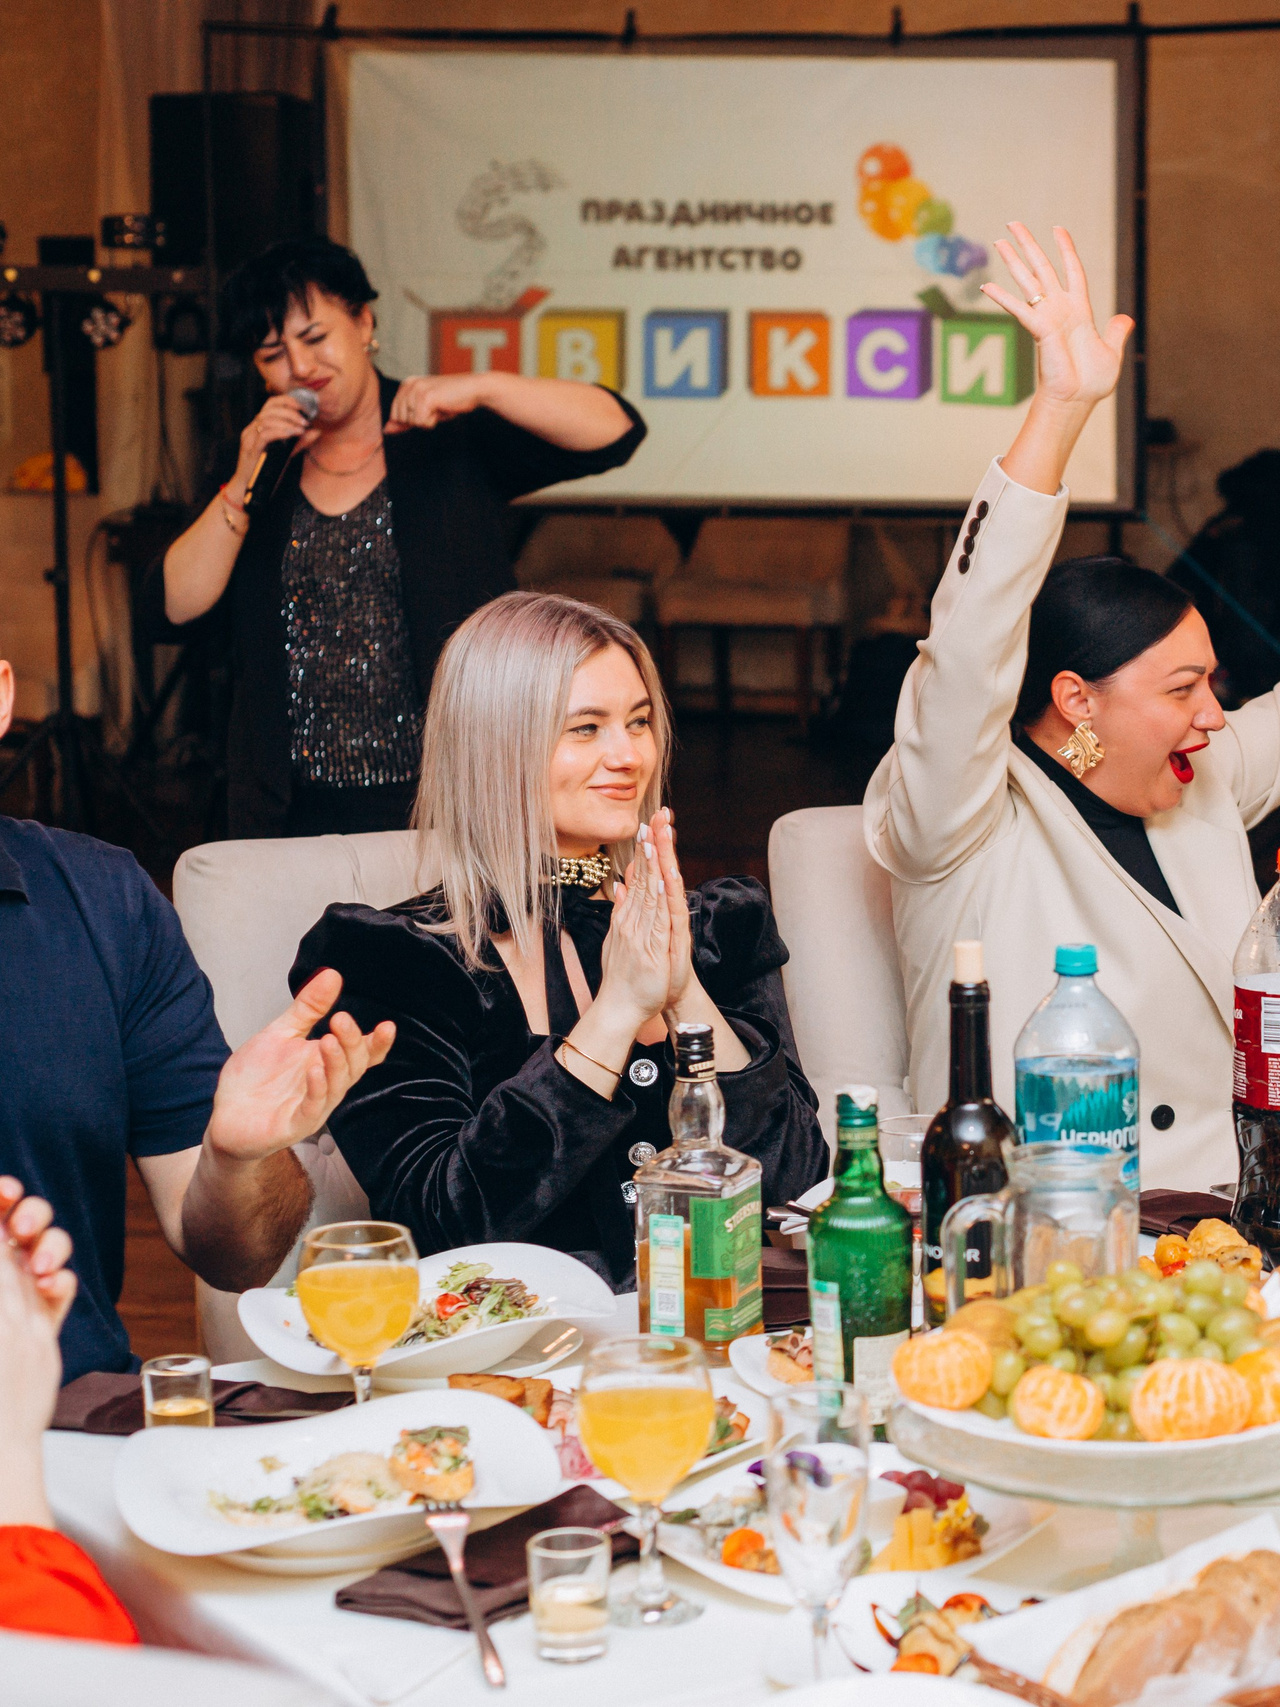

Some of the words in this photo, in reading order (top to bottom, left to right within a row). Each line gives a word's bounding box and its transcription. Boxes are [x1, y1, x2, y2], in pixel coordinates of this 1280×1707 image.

[581, 199, 833, 228] ПРАЗДНИЧНОЕ
[612, 245, 802, 270] АГЕНТСТВО
[457, 327, 1006, 396] ТВИКСИ
